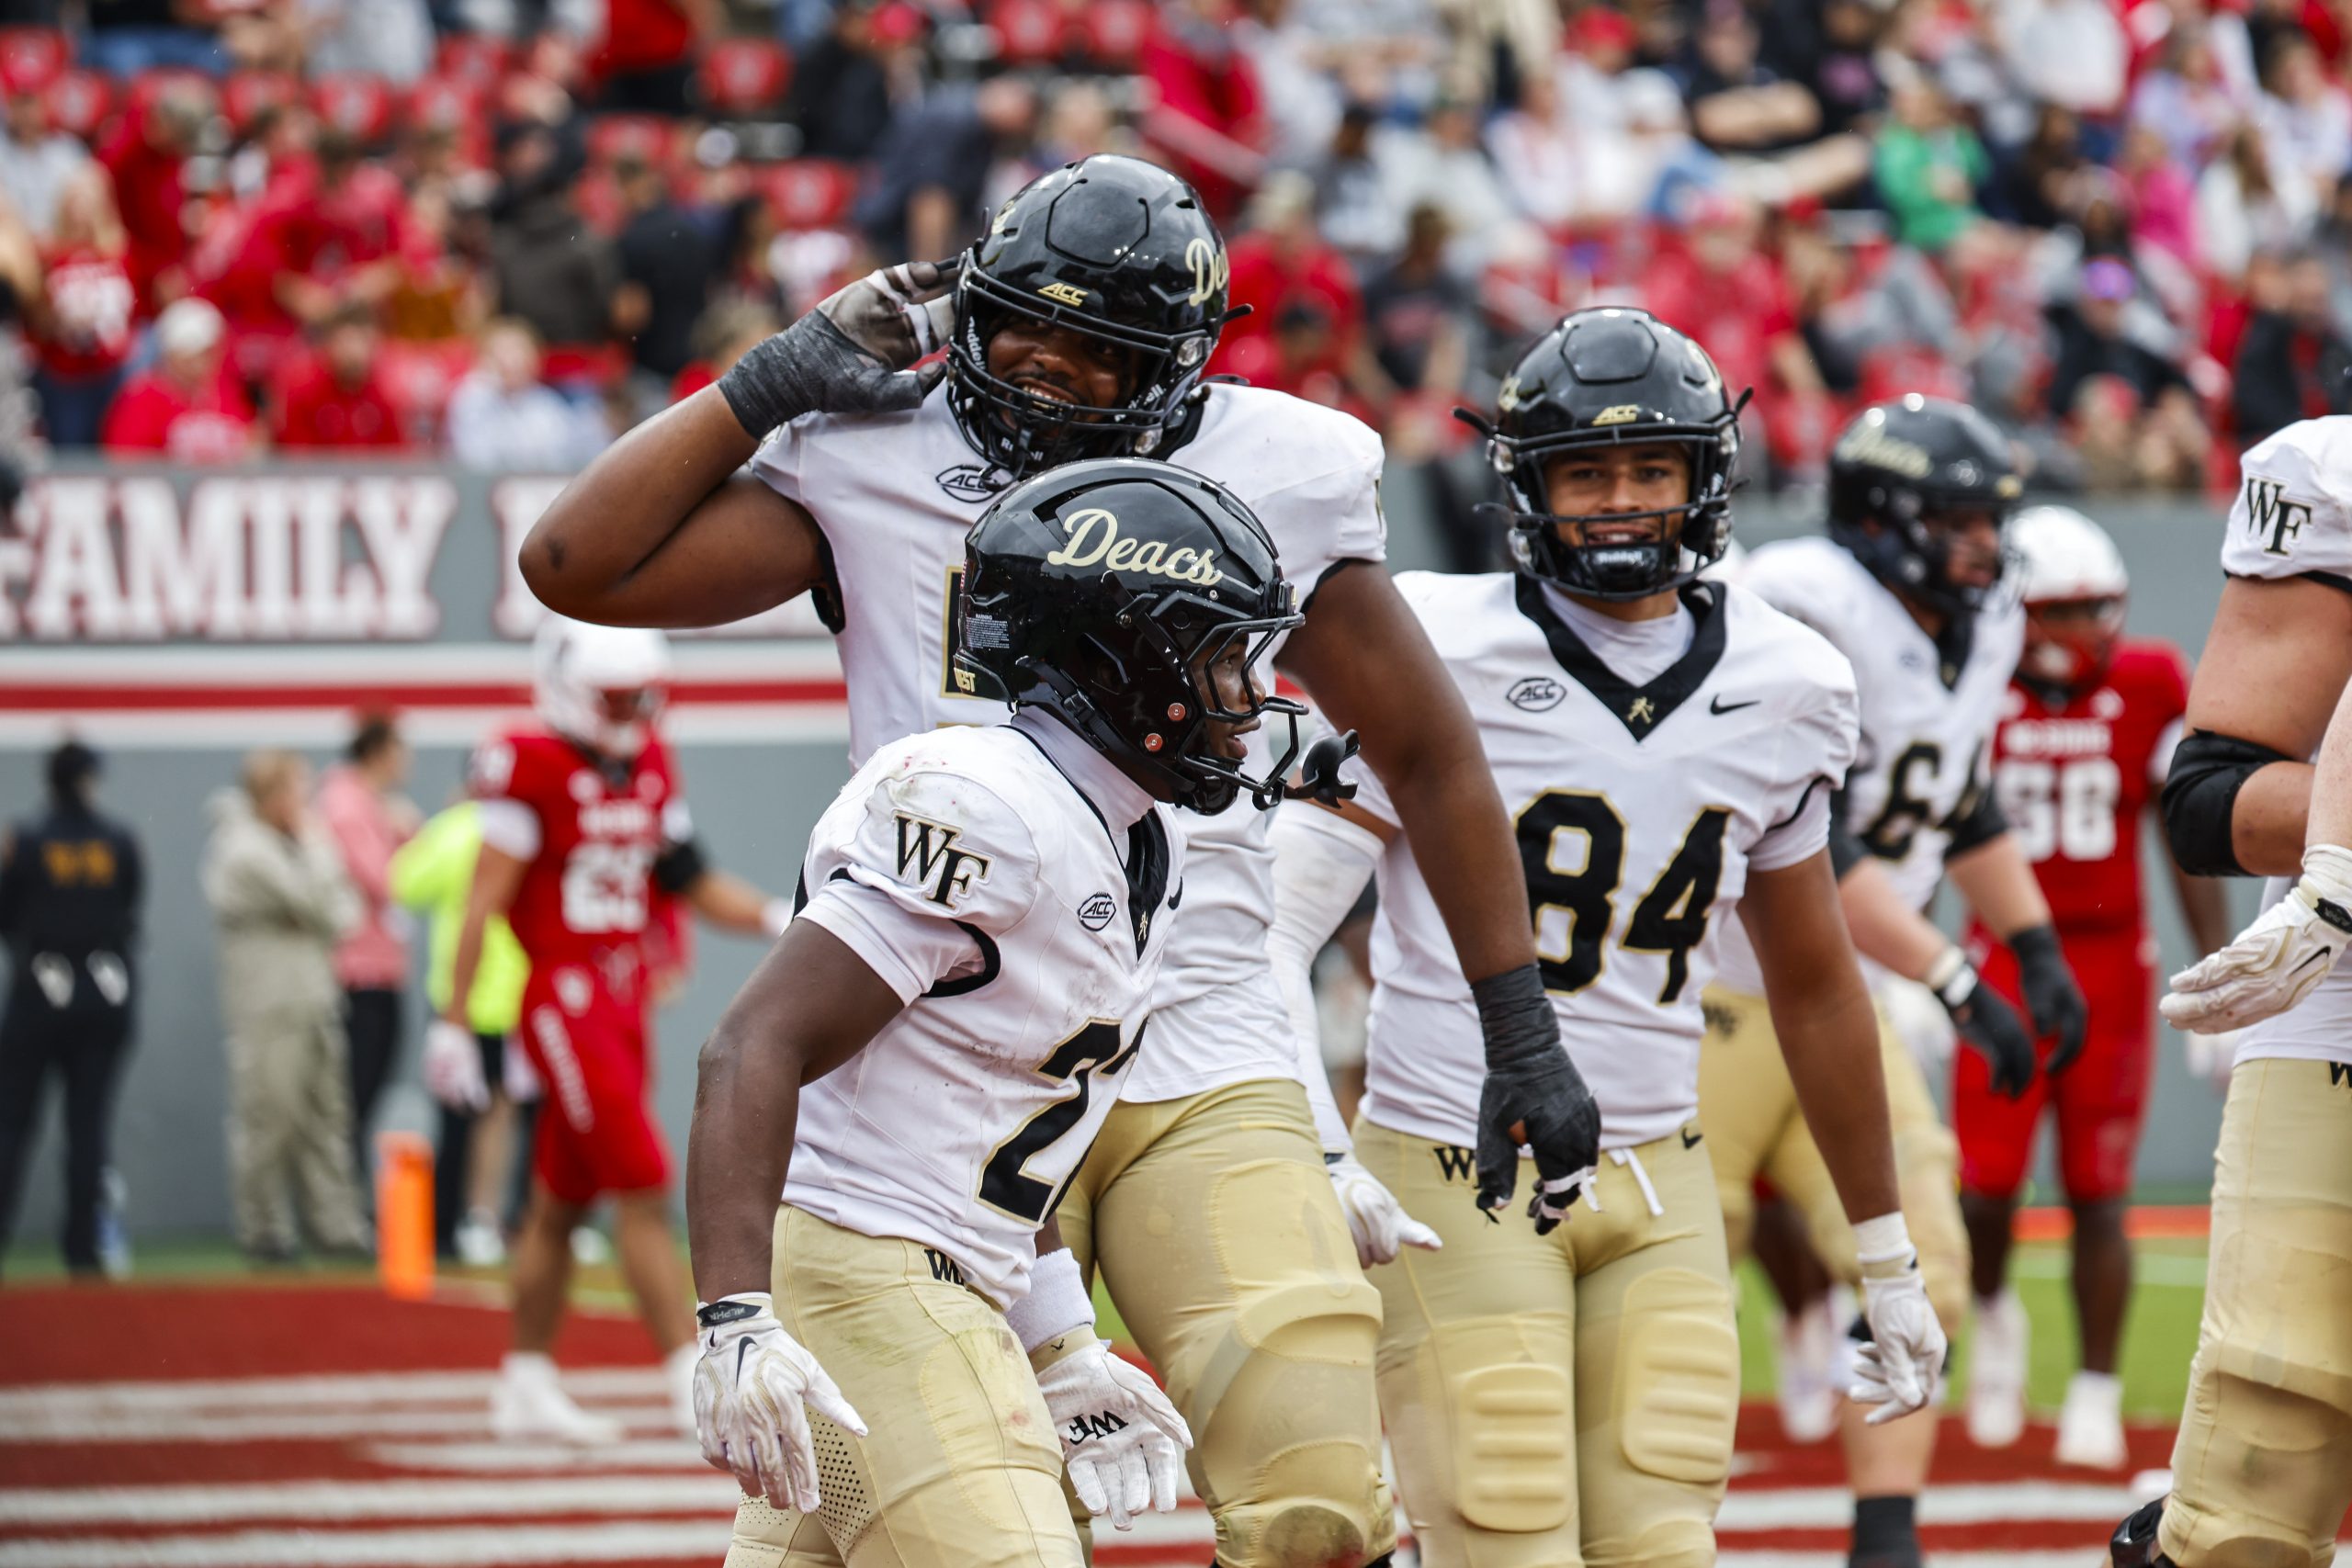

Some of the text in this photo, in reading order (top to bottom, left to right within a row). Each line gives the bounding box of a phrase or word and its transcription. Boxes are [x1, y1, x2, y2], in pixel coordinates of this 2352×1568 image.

[1036, 282, 1089, 307] ACC
[1592, 404, 1638, 425] ACC
[1047, 508, 1223, 586] Deacs
[2247, 476, 2312, 557] WF
[894, 813, 993, 910] WF
[1513, 786, 1734, 1008] 84
[974, 1014, 1150, 1232] 2
[1069, 1409, 1129, 1447] WF
